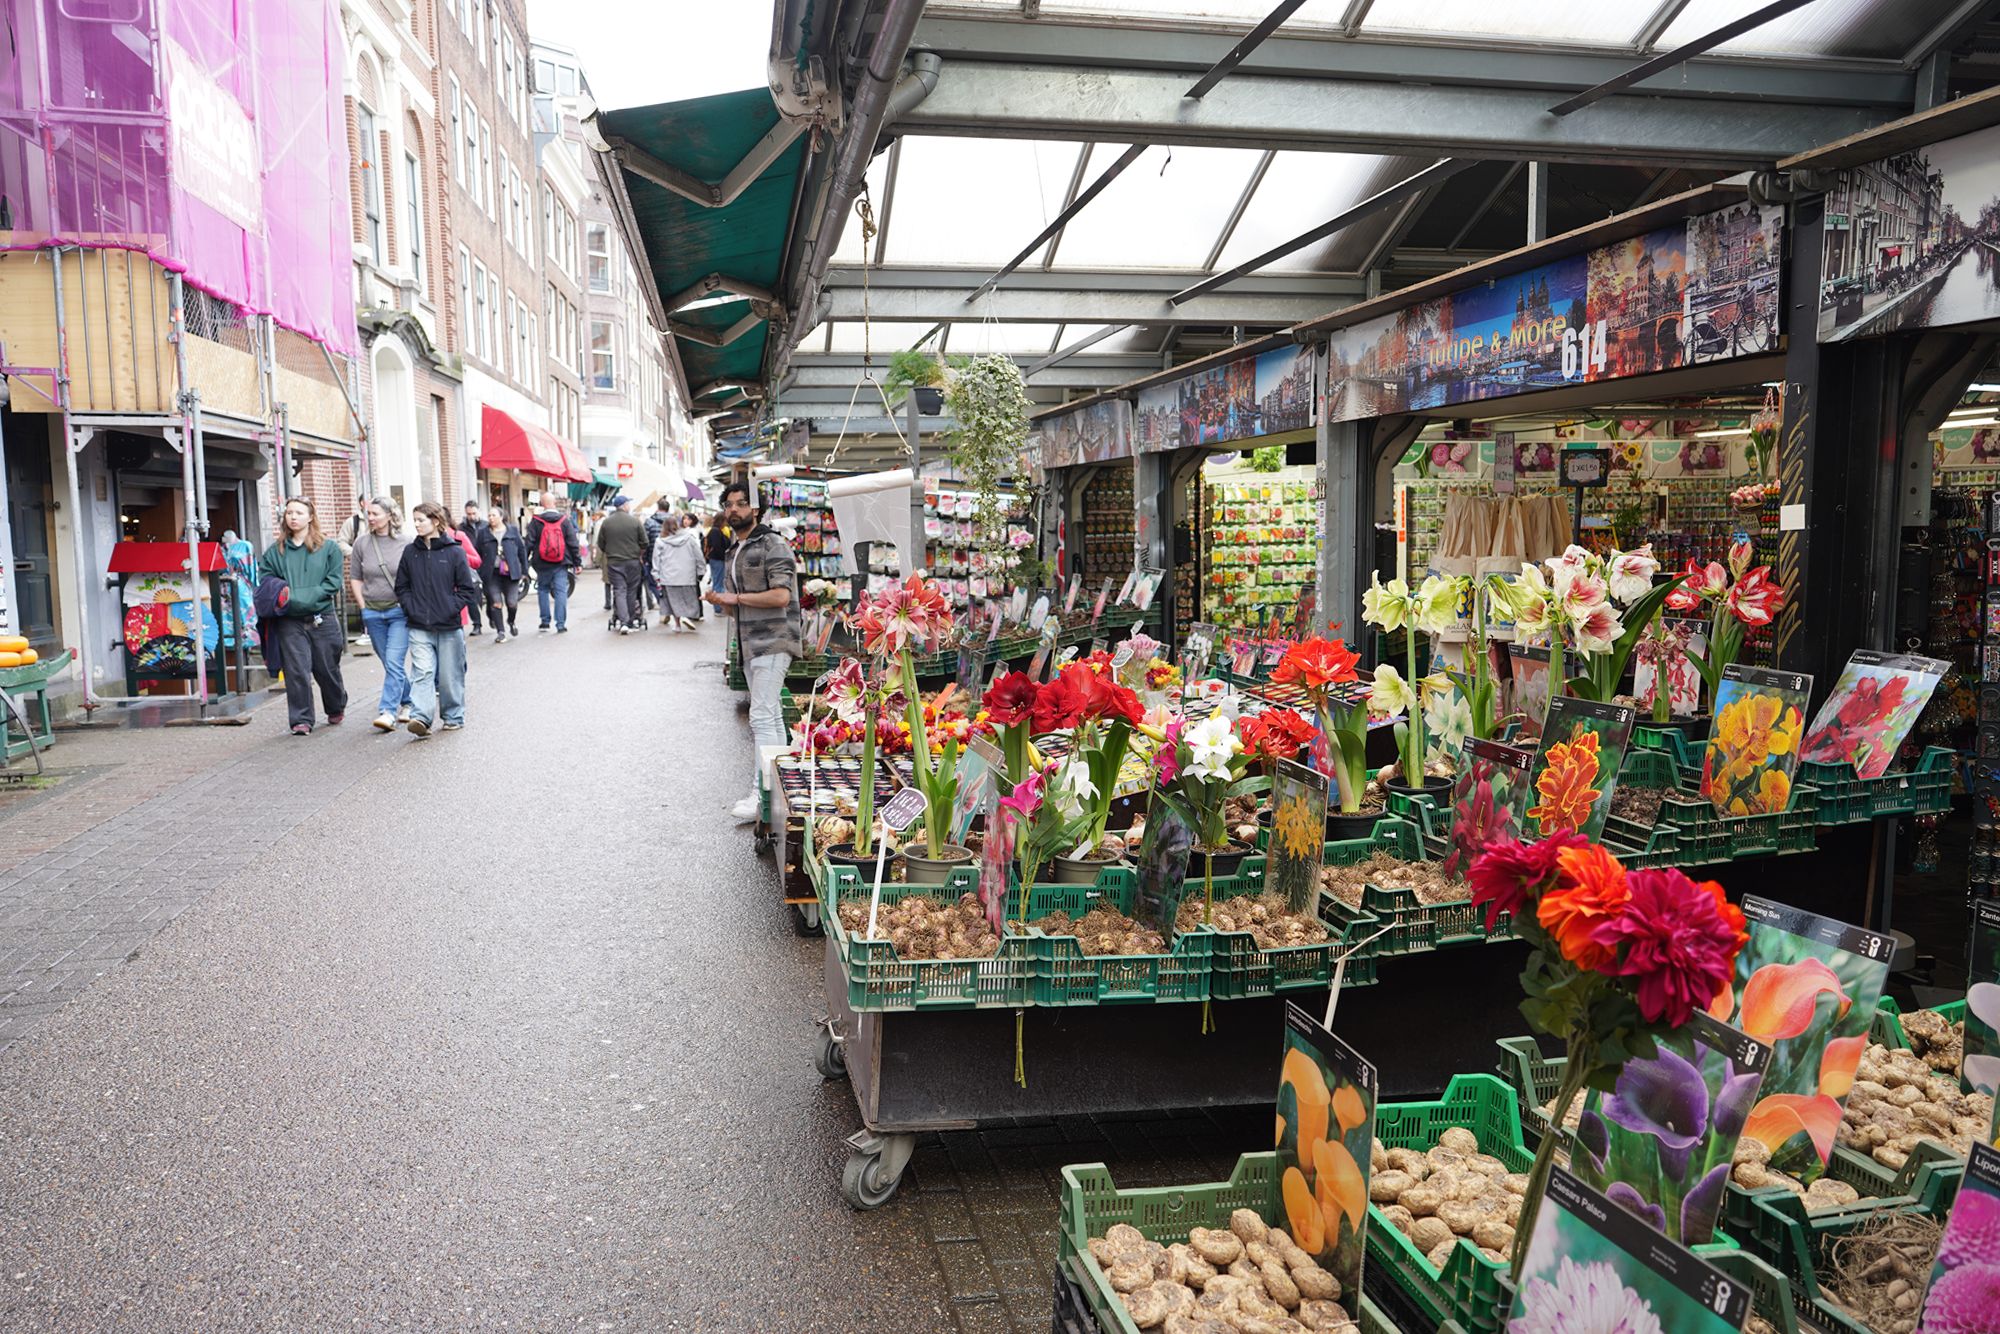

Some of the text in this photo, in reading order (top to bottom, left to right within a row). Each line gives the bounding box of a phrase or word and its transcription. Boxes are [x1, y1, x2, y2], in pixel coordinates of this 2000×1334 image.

[1427, 314, 1567, 369] Tulipe & More
[1561, 319, 1607, 379] 614
[1744, 903, 1768, 917] Morning
[1768, 909, 1781, 920] Sun
[1551, 1178, 1582, 1206] Caesars
[1579, 1197, 1608, 1223] Palace
